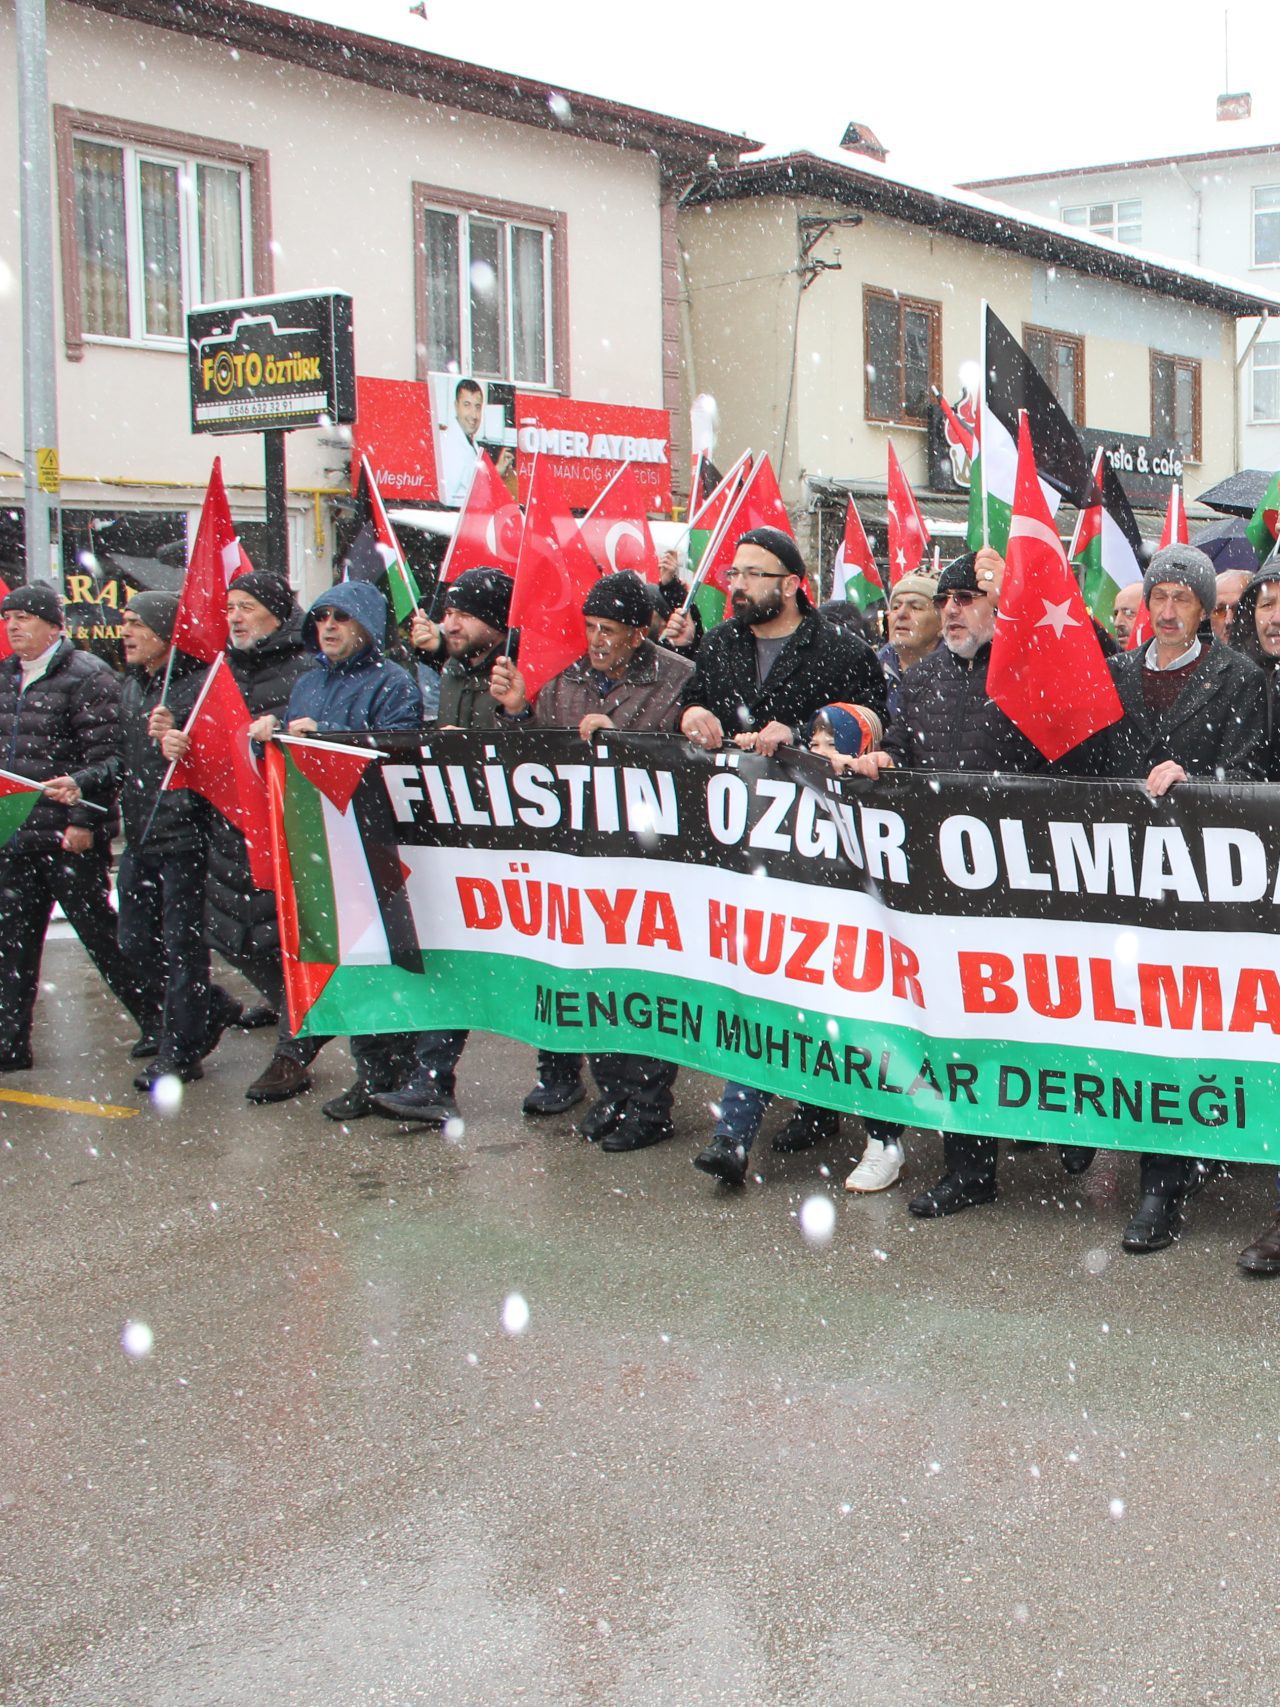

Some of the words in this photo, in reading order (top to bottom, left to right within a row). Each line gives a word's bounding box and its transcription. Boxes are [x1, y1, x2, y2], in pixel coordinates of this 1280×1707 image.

[203, 351, 262, 395] FOTO
[264, 352, 321, 385] ÖZTÜRK
[519, 417, 590, 458] ÖMER
[590, 433, 668, 464] AYBAK
[1105, 443, 1133, 471] asta
[1137, 446, 1149, 473] &
[381, 745, 679, 837] FİLİSTİN
[707, 754, 910, 885] ÖZGÜR
[455, 862, 684, 952] DÜNYA
[708, 899, 926, 1009] HUZUR
[534, 984, 703, 1043] MENGEN
[715, 1009, 979, 1105] MUHTARLAR
[997, 1064, 1247, 1129] DERNEĞİ
